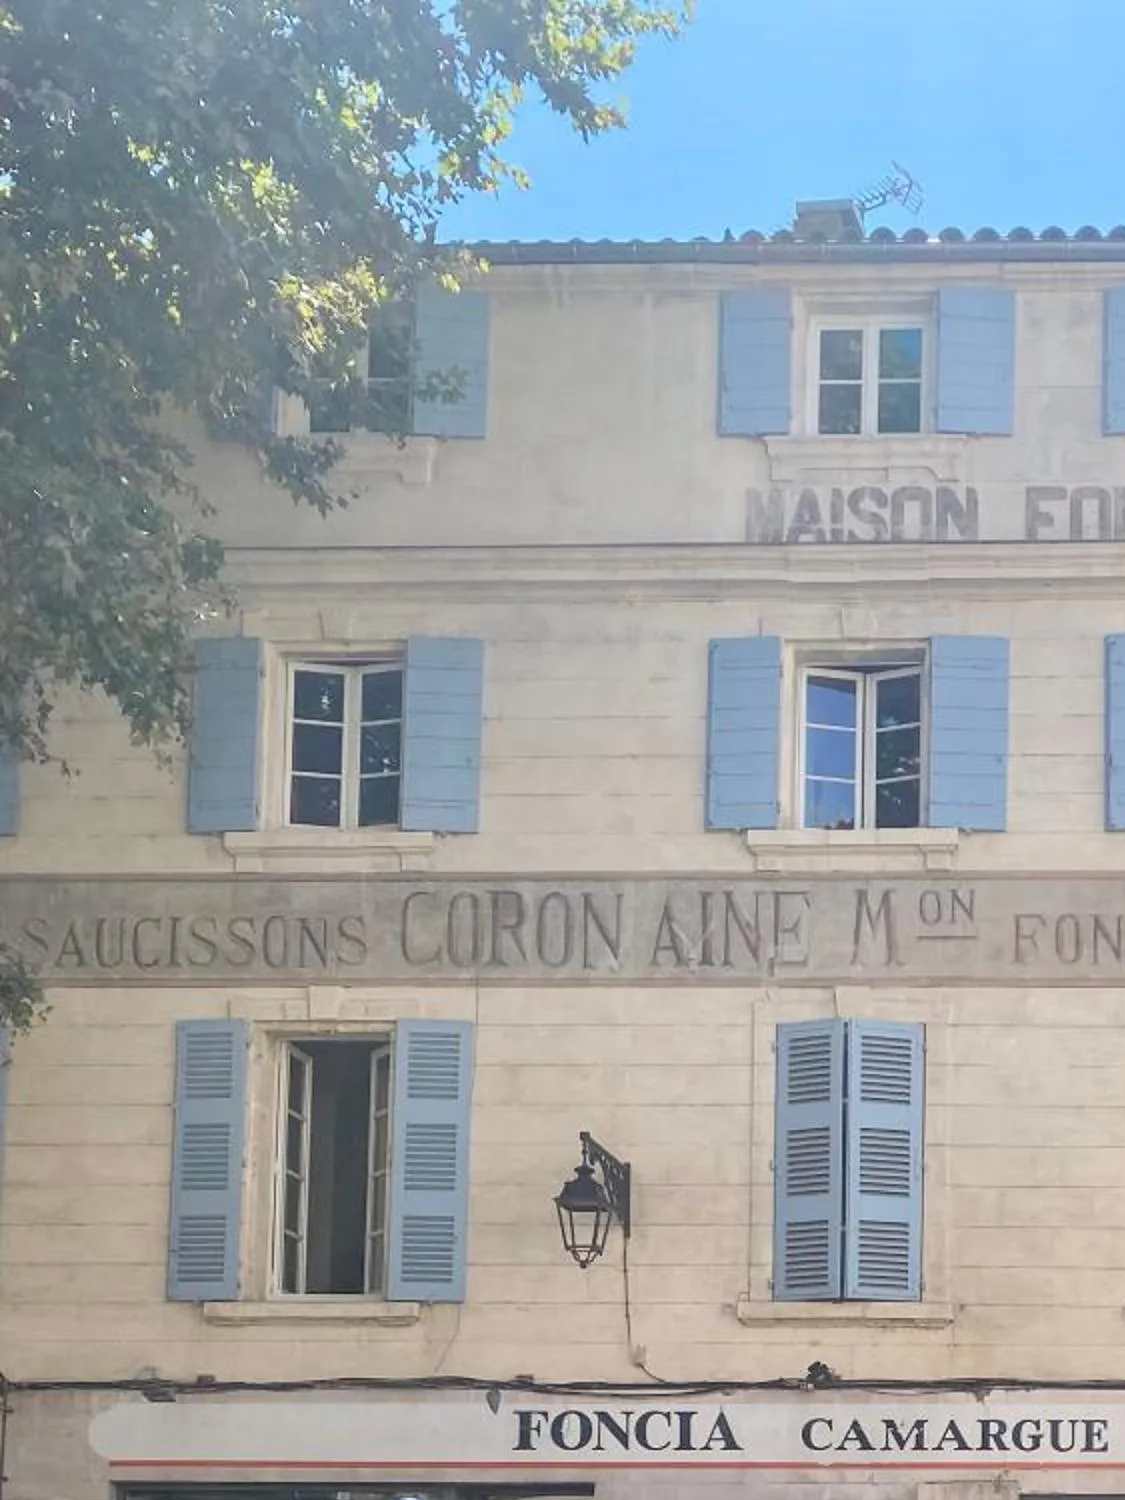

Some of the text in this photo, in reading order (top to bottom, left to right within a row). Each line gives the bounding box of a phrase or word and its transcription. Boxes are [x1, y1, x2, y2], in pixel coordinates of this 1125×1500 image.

[746, 486, 979, 542] MAISON
[24, 914, 368, 970] SAUCISSONS
[402, 889, 625, 970] CORON
[650, 889, 810, 975] AINE
[512, 1408, 1109, 1453] FONCIA CAMARGUE
